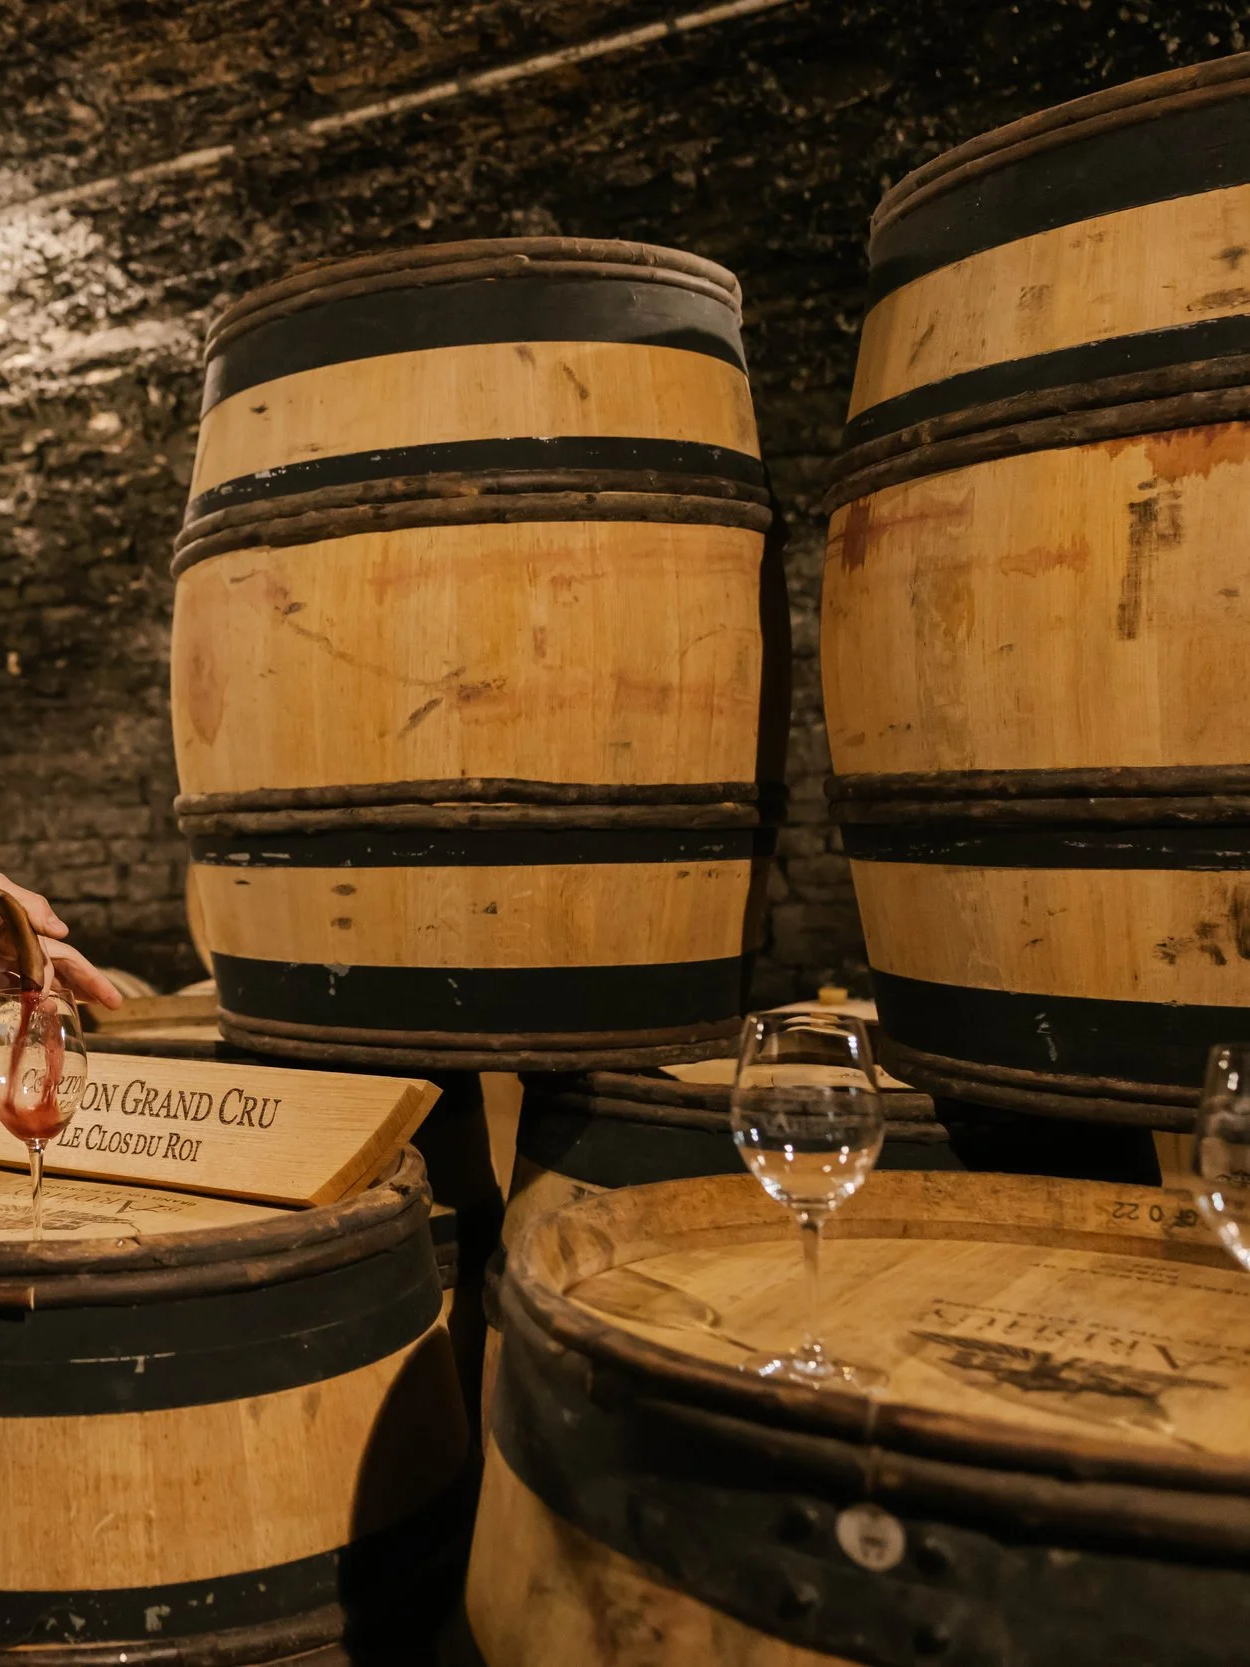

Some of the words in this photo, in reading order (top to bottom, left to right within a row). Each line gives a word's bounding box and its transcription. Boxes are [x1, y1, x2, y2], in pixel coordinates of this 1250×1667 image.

[120, 1079, 214, 1122] GRAND
[218, 1087, 282, 1129] CRU
[56, 1126, 84, 1148] LE
[85, 1124, 133, 1155] CLOS
[131, 1133, 163, 1157] DU
[162, 1132, 203, 1162] ROI
